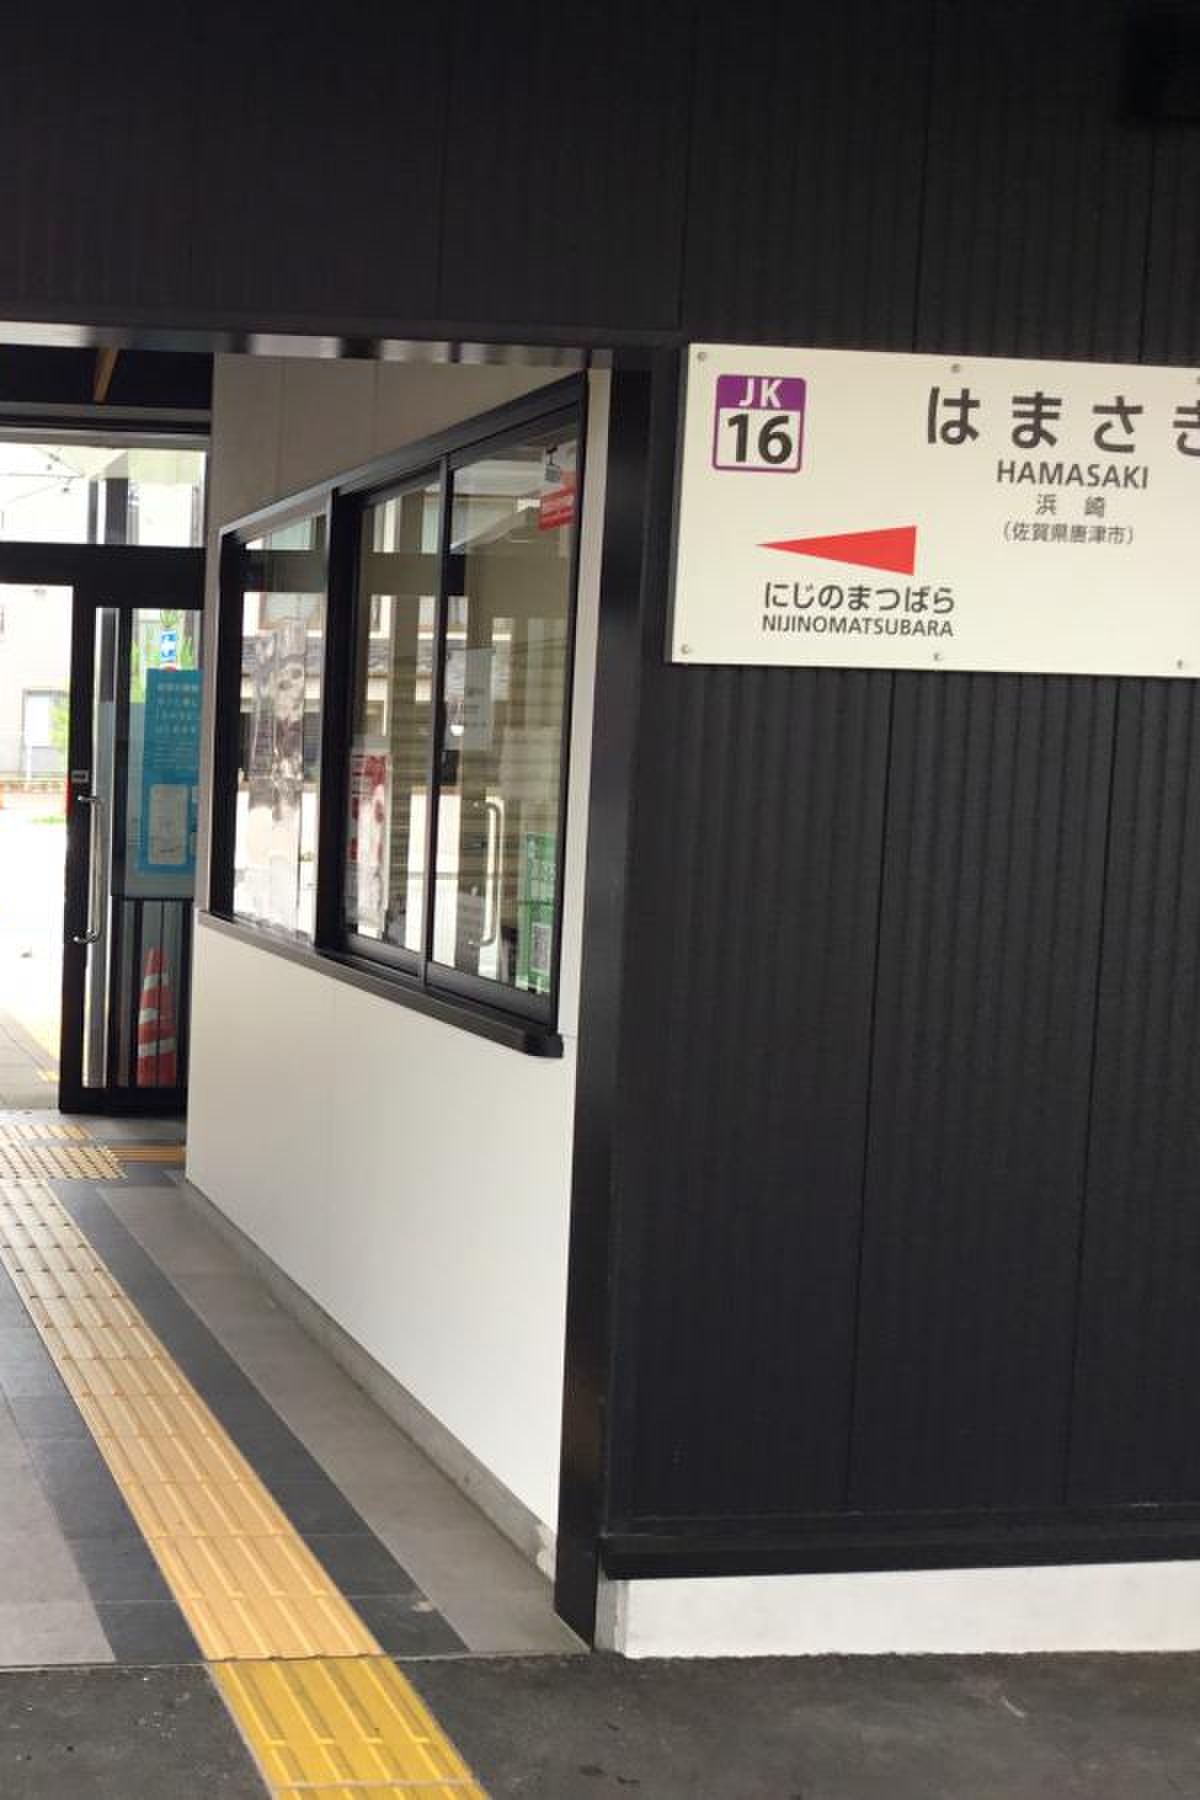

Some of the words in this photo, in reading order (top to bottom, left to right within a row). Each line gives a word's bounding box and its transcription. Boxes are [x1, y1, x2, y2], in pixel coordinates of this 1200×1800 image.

[738, 378, 784, 409] JK
[726, 412, 794, 466] 16
[995, 458, 1150, 491] HAMASAKI
[763, 581, 956, 615] にじのまつばら
[761, 614, 955, 638] NIJINOMATSUBARA
